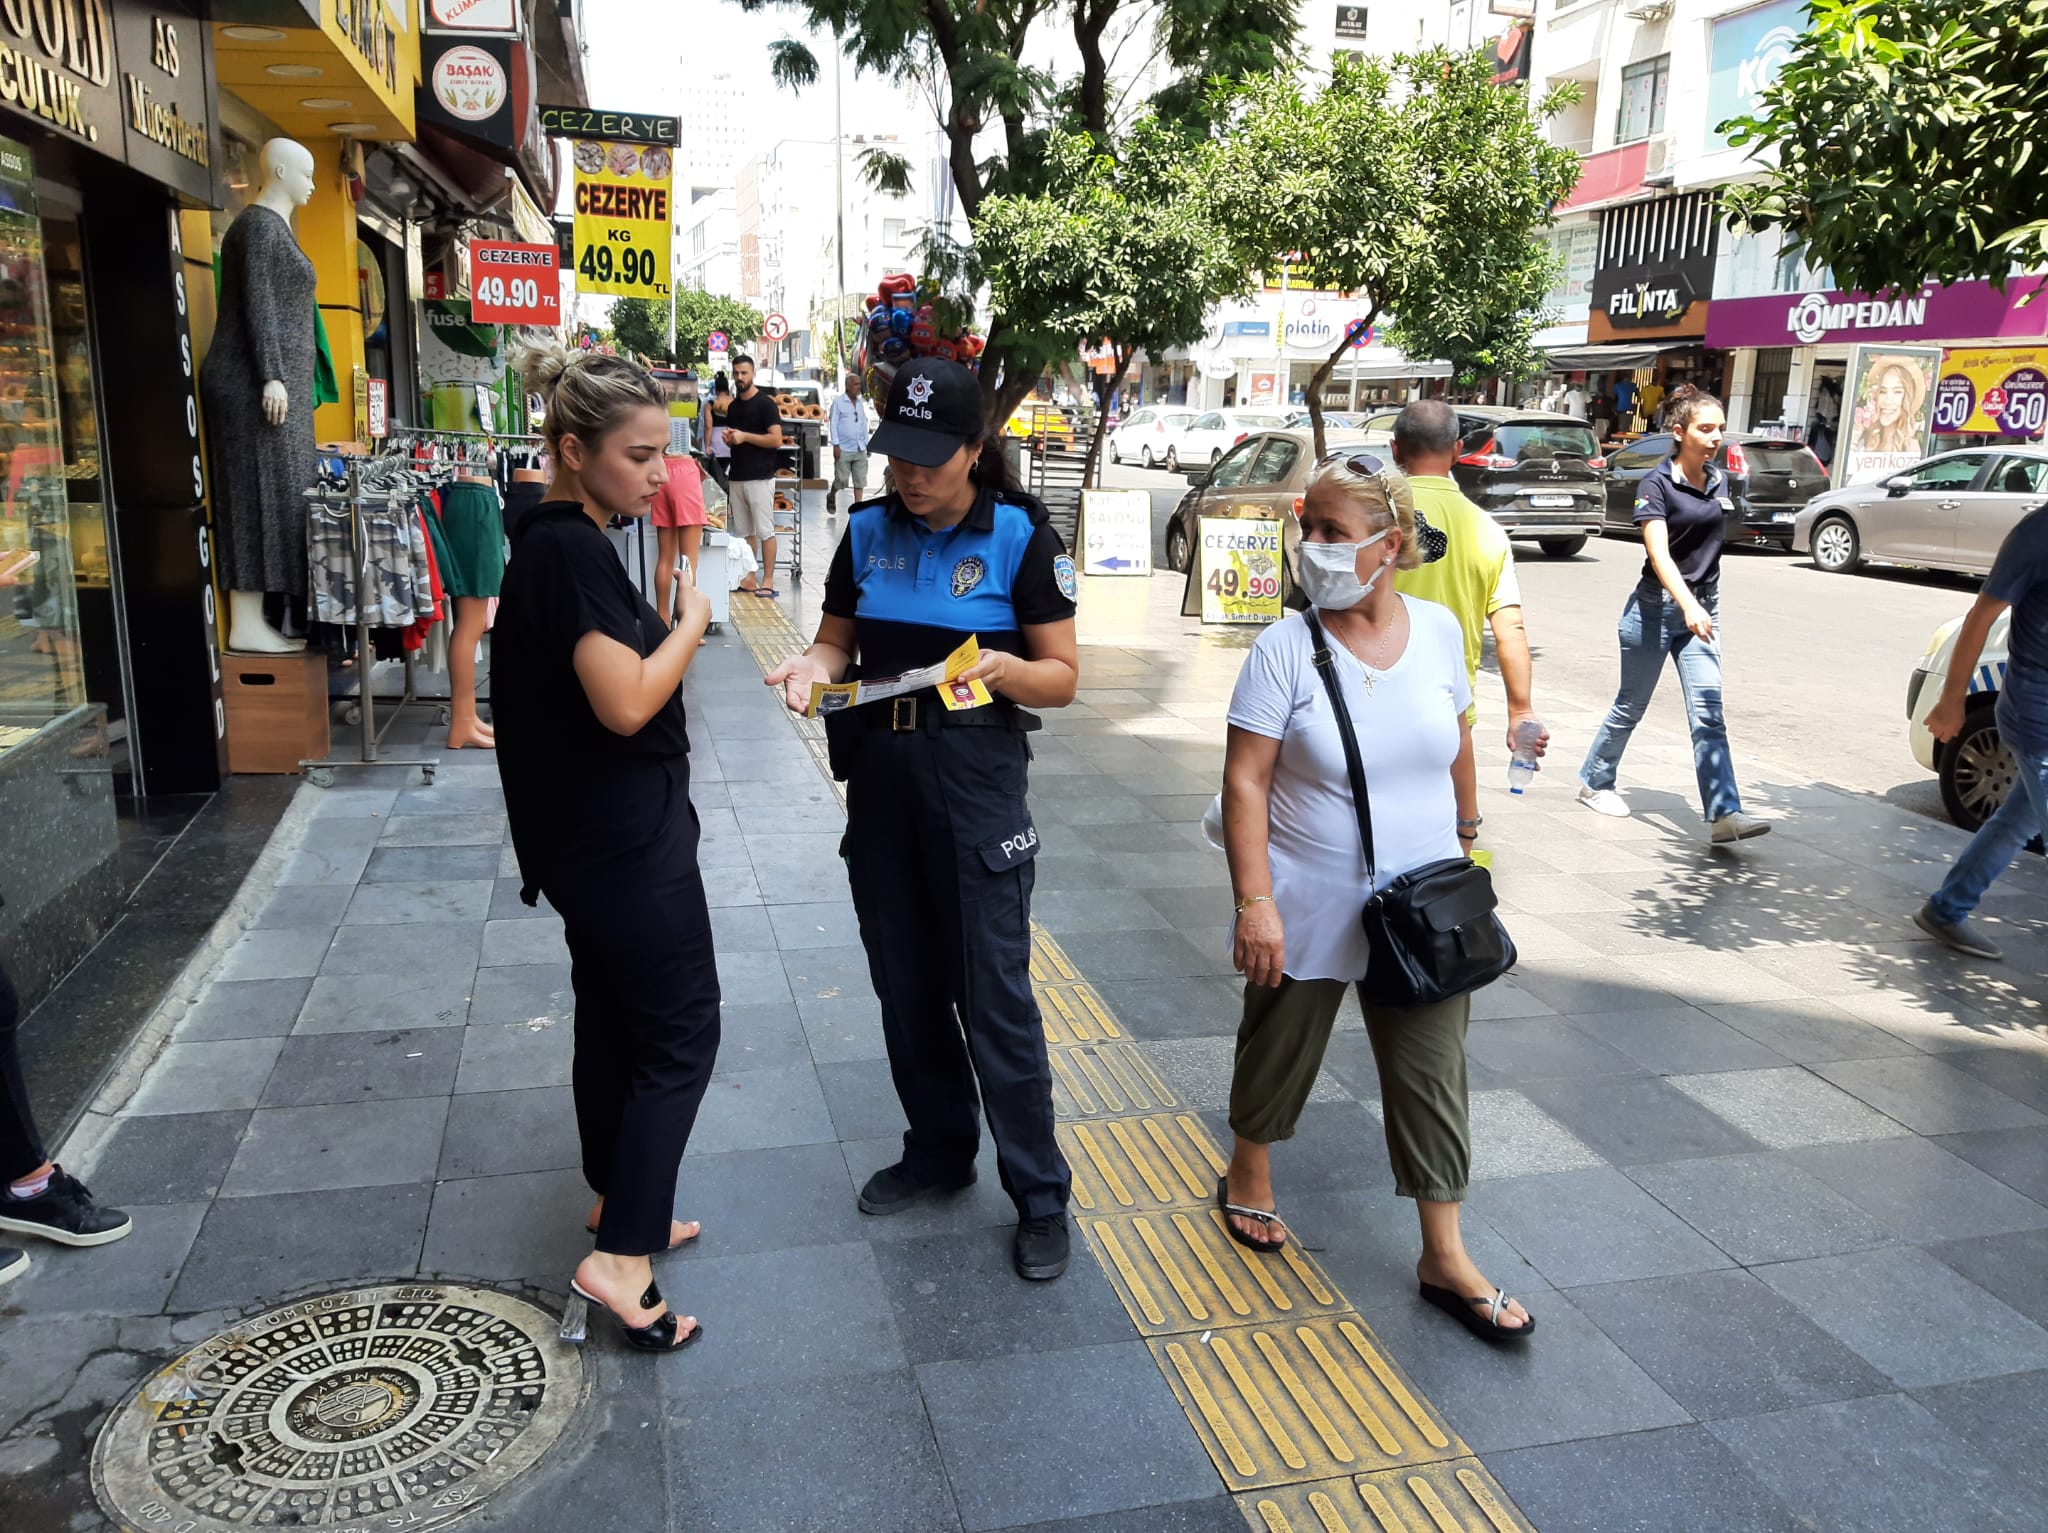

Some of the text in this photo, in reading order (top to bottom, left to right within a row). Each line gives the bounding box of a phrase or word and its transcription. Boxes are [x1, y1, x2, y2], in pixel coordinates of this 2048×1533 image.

[155, 17, 180, 78] AS
[446, 64, 494, 79] BAŞAK
[542, 109, 675, 138] CEZERYE
[575, 182, 667, 221] CEZERYE
[608, 229, 632, 242] KG
[479, 249, 553, 267] CEZERYE
[579, 244, 656, 286] 49.90
[654, 284, 671, 295] TL
[476, 276, 558, 308] 49.90 TL
[426, 309, 467, 327] fuse
[1787, 294, 1927, 342] KOMPEDAN
[1285, 319, 1331, 337] platin
[899, 405, 933, 420] POLİS
[1205, 534, 1278, 551] CEZERYE
[867, 555, 905, 570] POLİS
